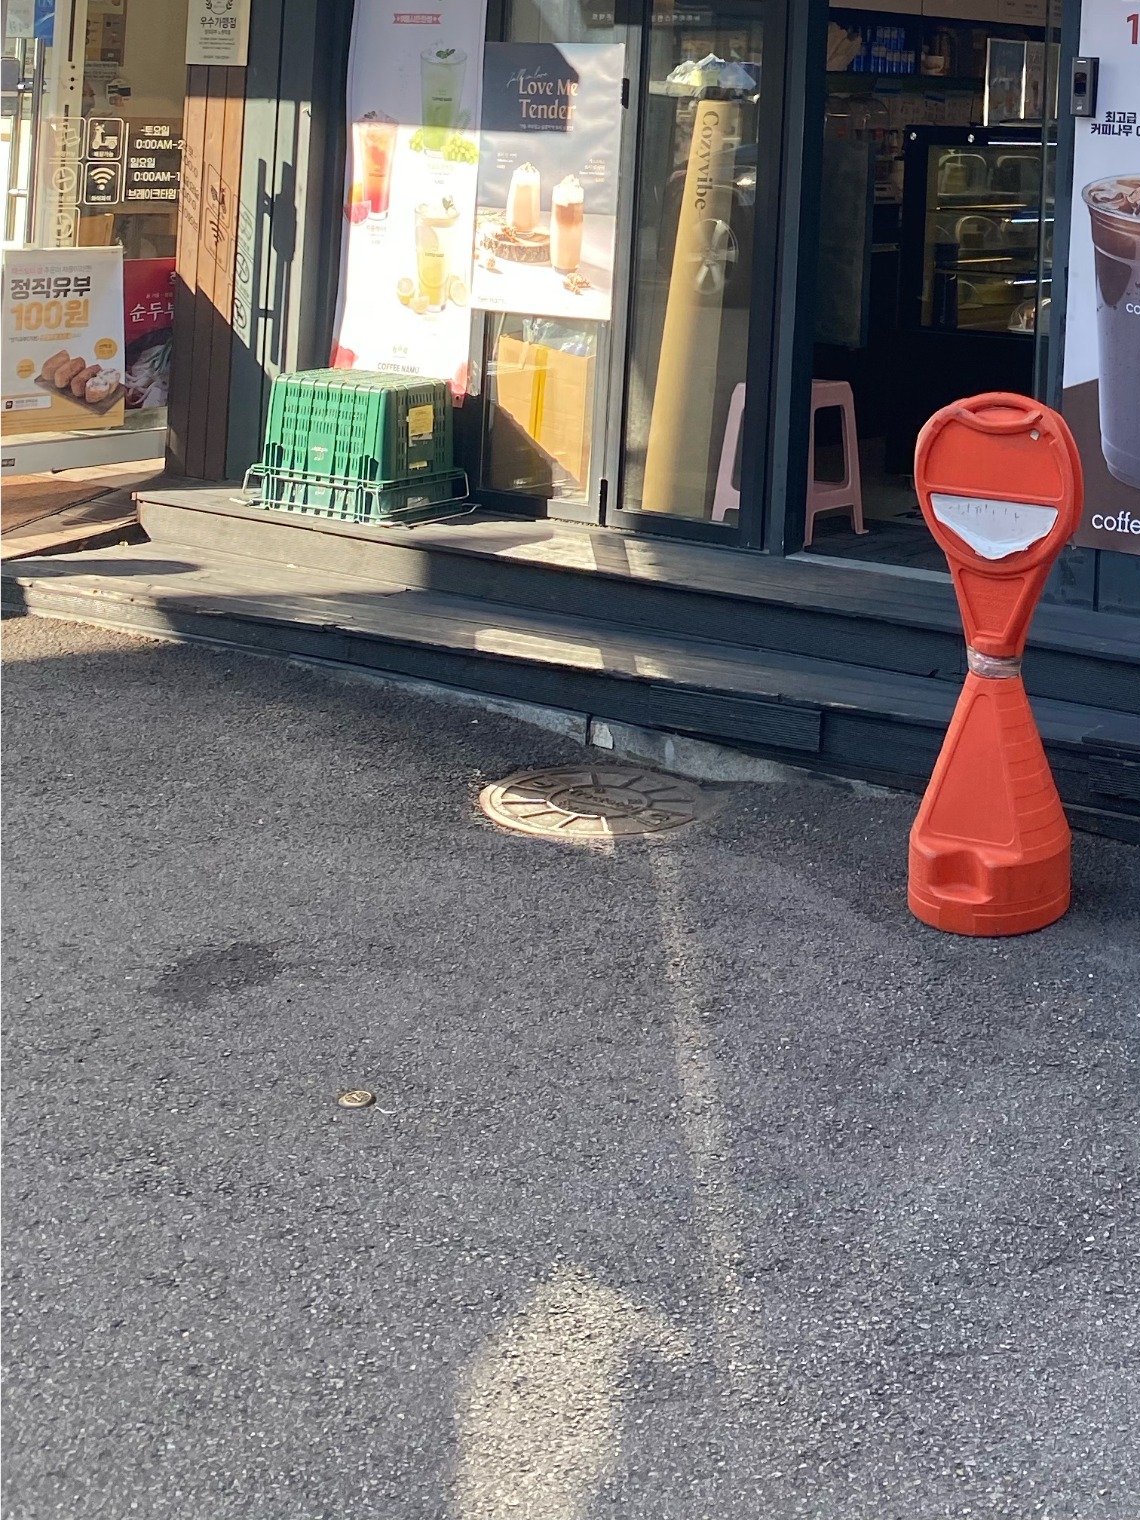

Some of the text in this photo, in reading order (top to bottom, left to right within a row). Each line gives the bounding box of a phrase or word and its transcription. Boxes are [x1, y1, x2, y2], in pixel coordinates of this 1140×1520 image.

[519, 79, 579, 97] Love Me
[519, 99, 576, 119] Tender
[1105, 111, 1137, 124] 최고급
[1091, 123, 1133, 136] 커피나무
[694, 111, 720, 210] Cozyvibe
[128, 189, 177, 199] 브레이크타임
[10, 276, 91, 300] 정직유부
[10, 298, 90, 331] 100원
[377, 362, 420, 374] COFFEE NAMU
